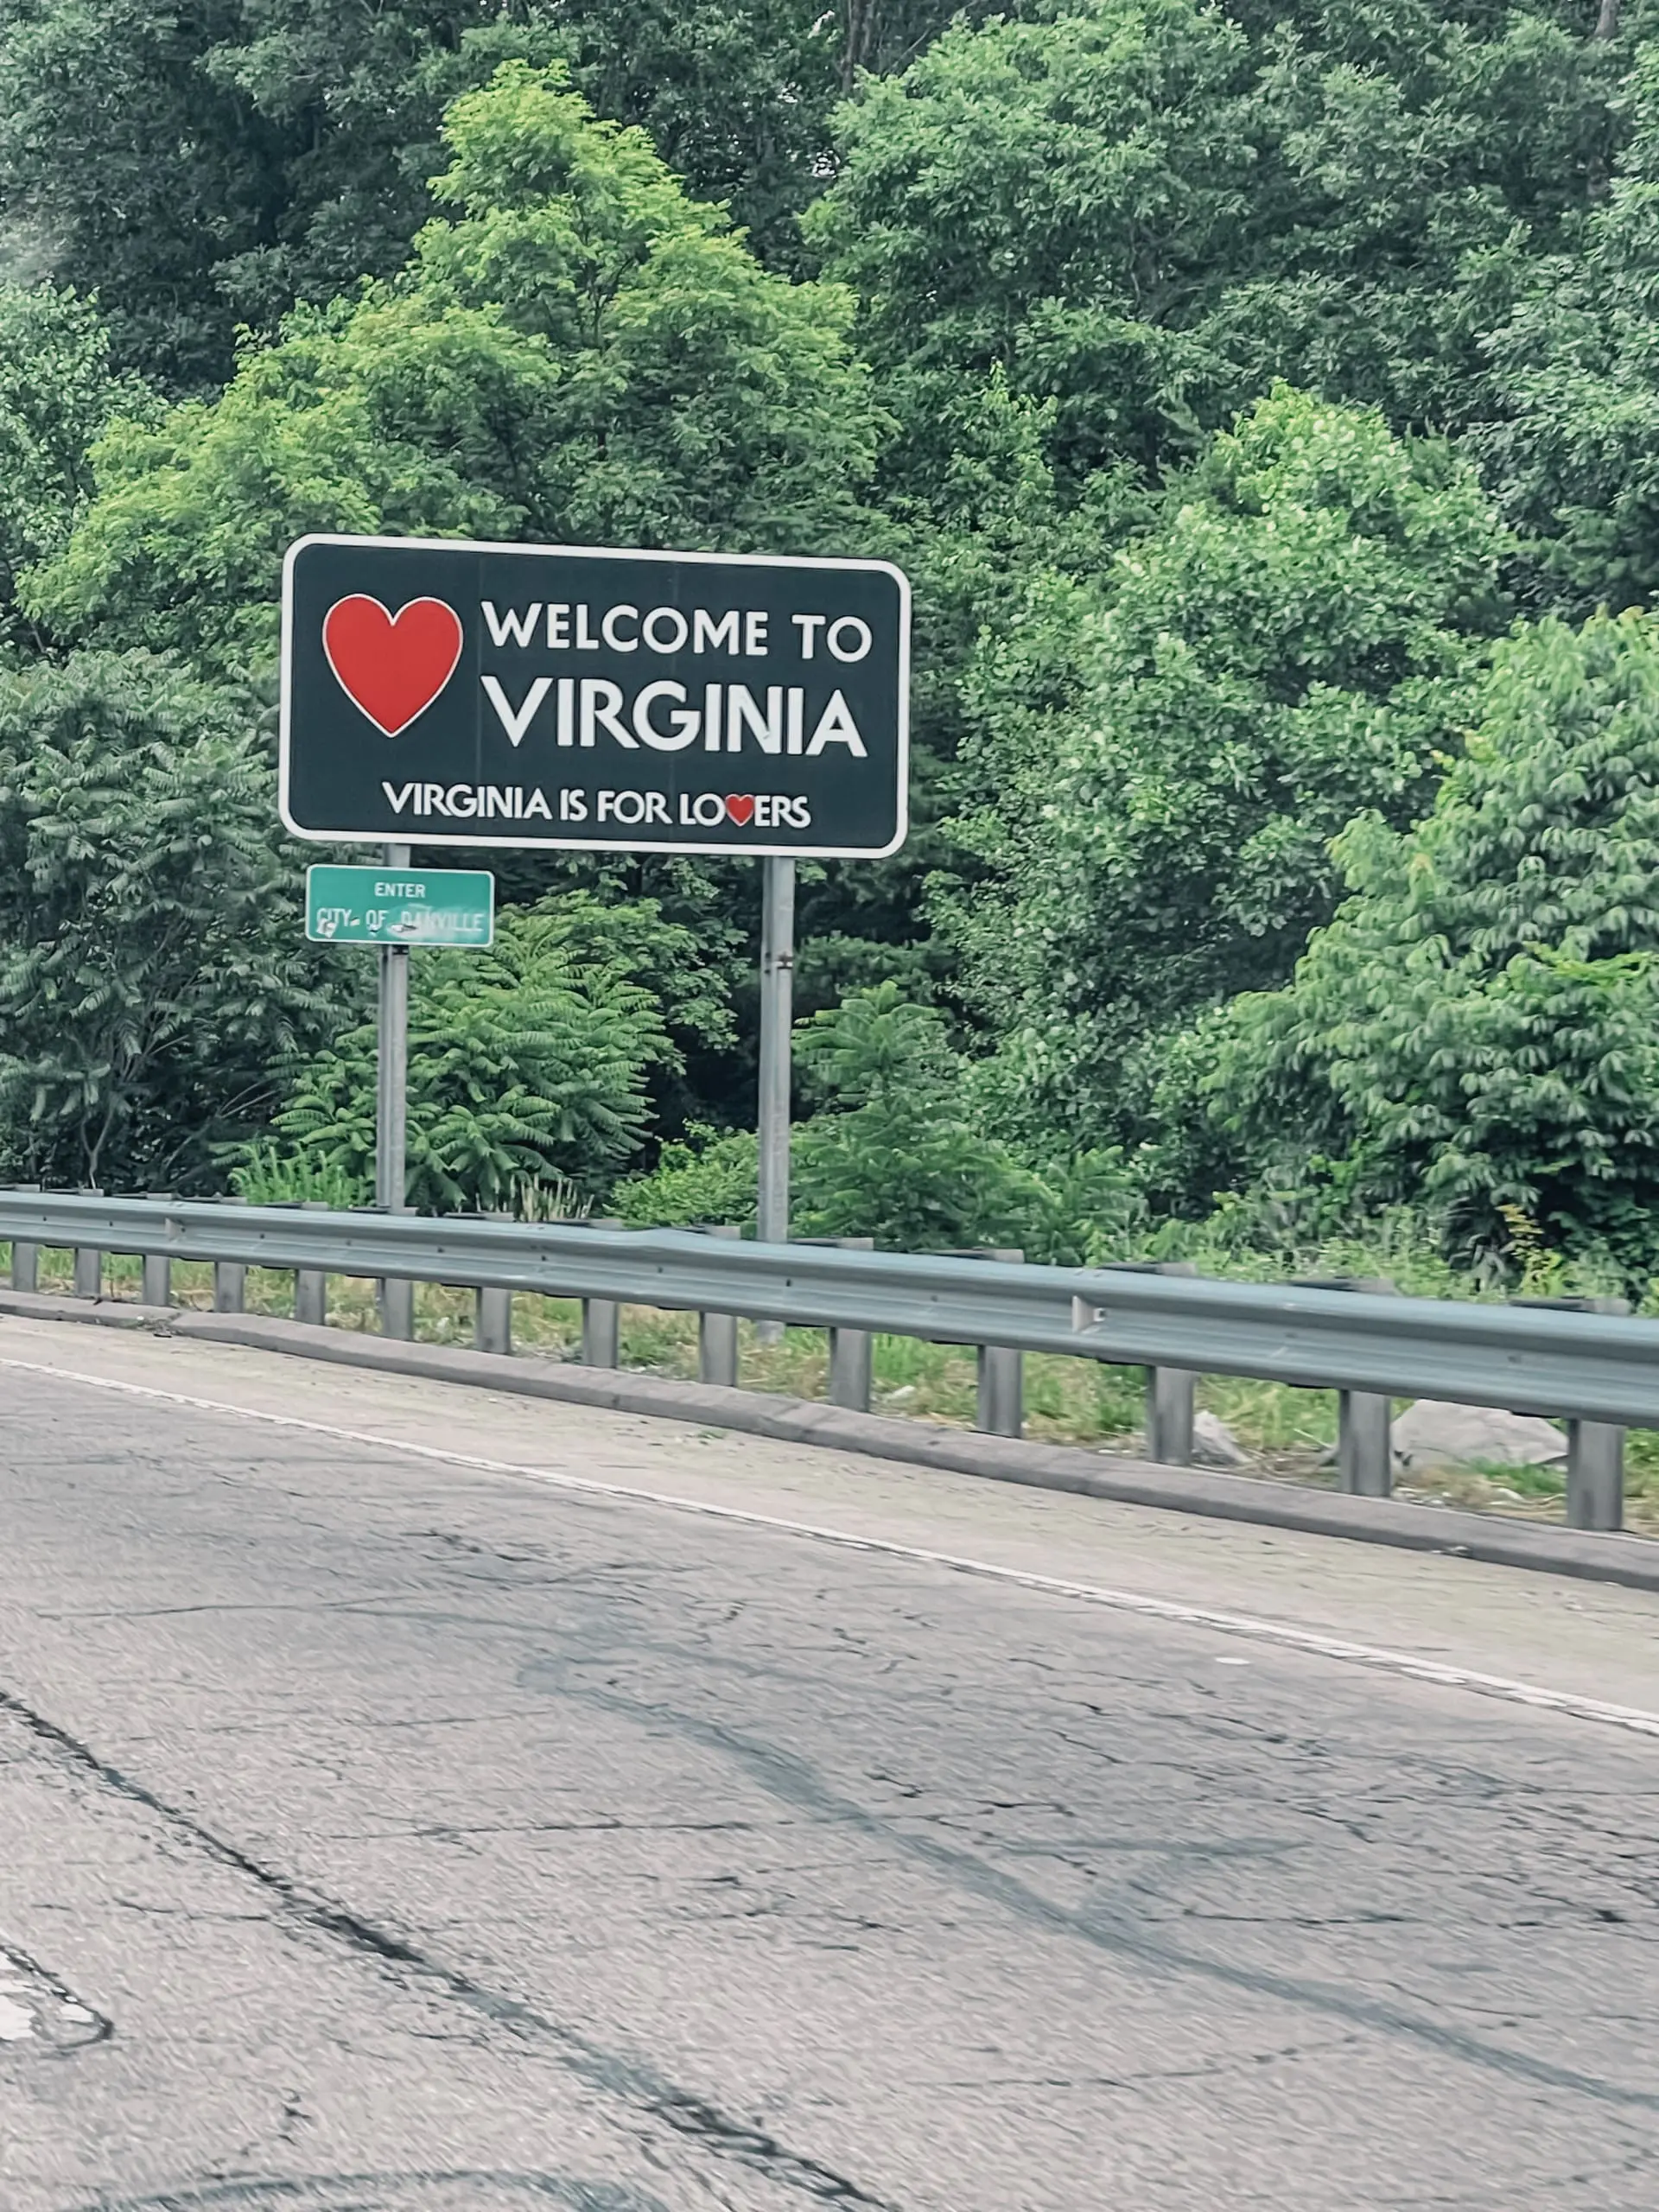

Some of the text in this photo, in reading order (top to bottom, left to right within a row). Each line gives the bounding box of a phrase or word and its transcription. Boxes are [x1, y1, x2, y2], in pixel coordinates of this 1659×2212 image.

[481, 601, 872, 663] WELCOME TO
[480, 675, 868, 757] VIRGINIA
[382, 782, 551, 820] VIRGINIA
[560, 789, 588, 822] IS
[598, 790, 671, 824] FOR
[374, 881, 426, 898] ENTER
[316, 908, 353, 927] CITY
[365, 910, 389, 931] OF
